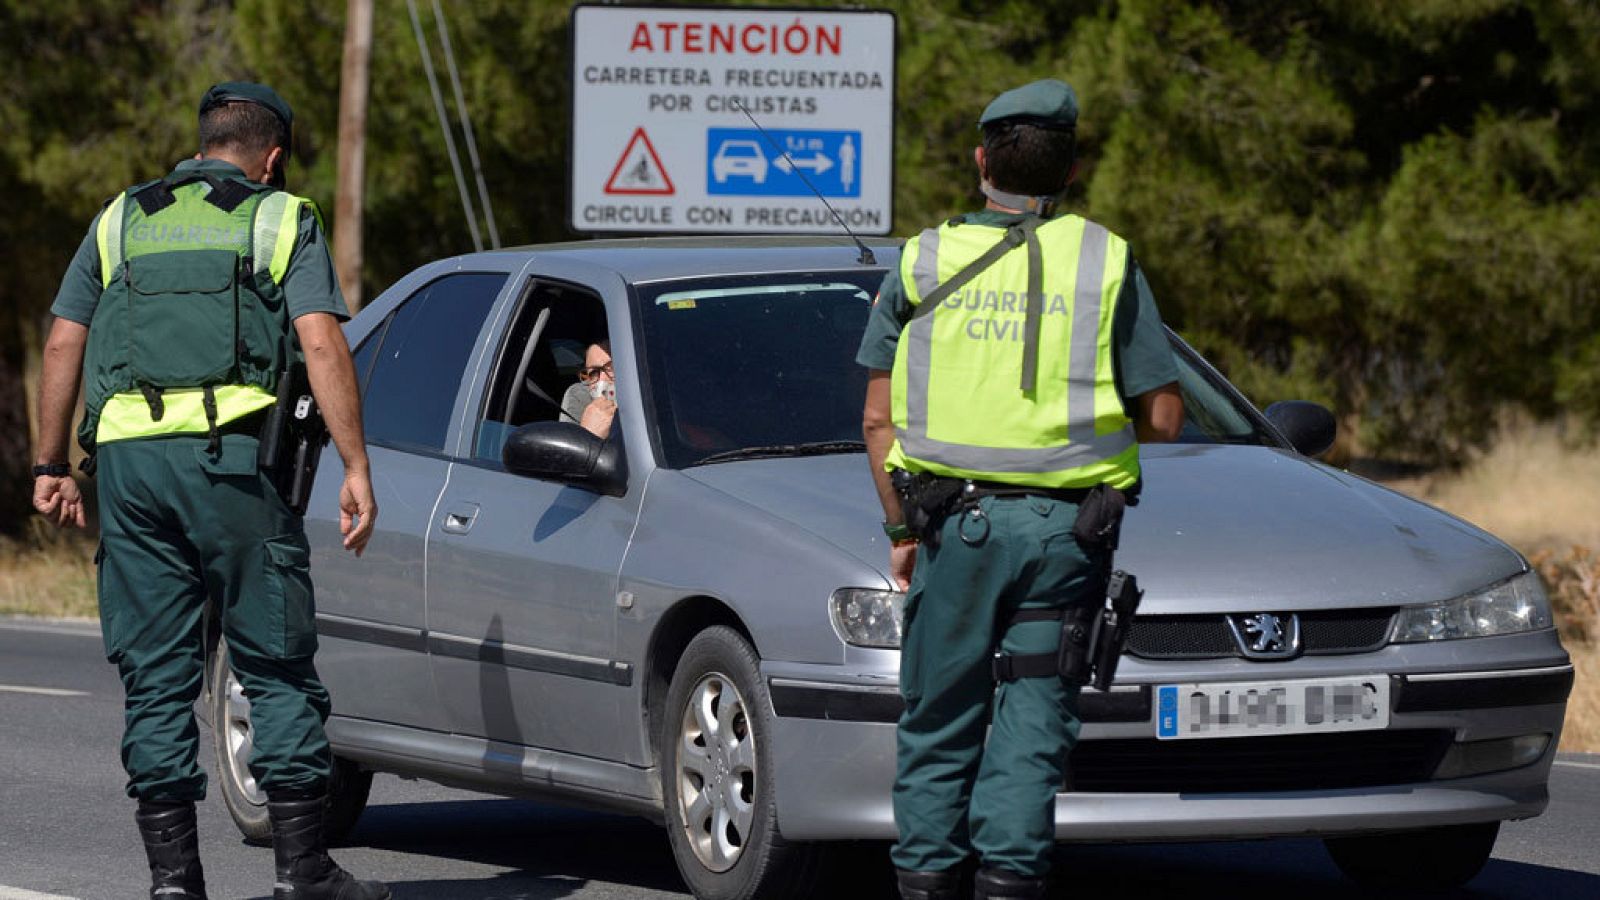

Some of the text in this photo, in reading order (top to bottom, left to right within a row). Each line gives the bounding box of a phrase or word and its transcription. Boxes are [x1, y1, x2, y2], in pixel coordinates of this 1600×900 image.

[629, 18, 842, 56] ATENCIÓN
[584, 65, 883, 90] CARRETERA FRECUENTADA
[649, 93, 818, 115] POR CICLISTAS
[583, 203, 882, 227] CIRCULE CON PRECAUCIÓN
